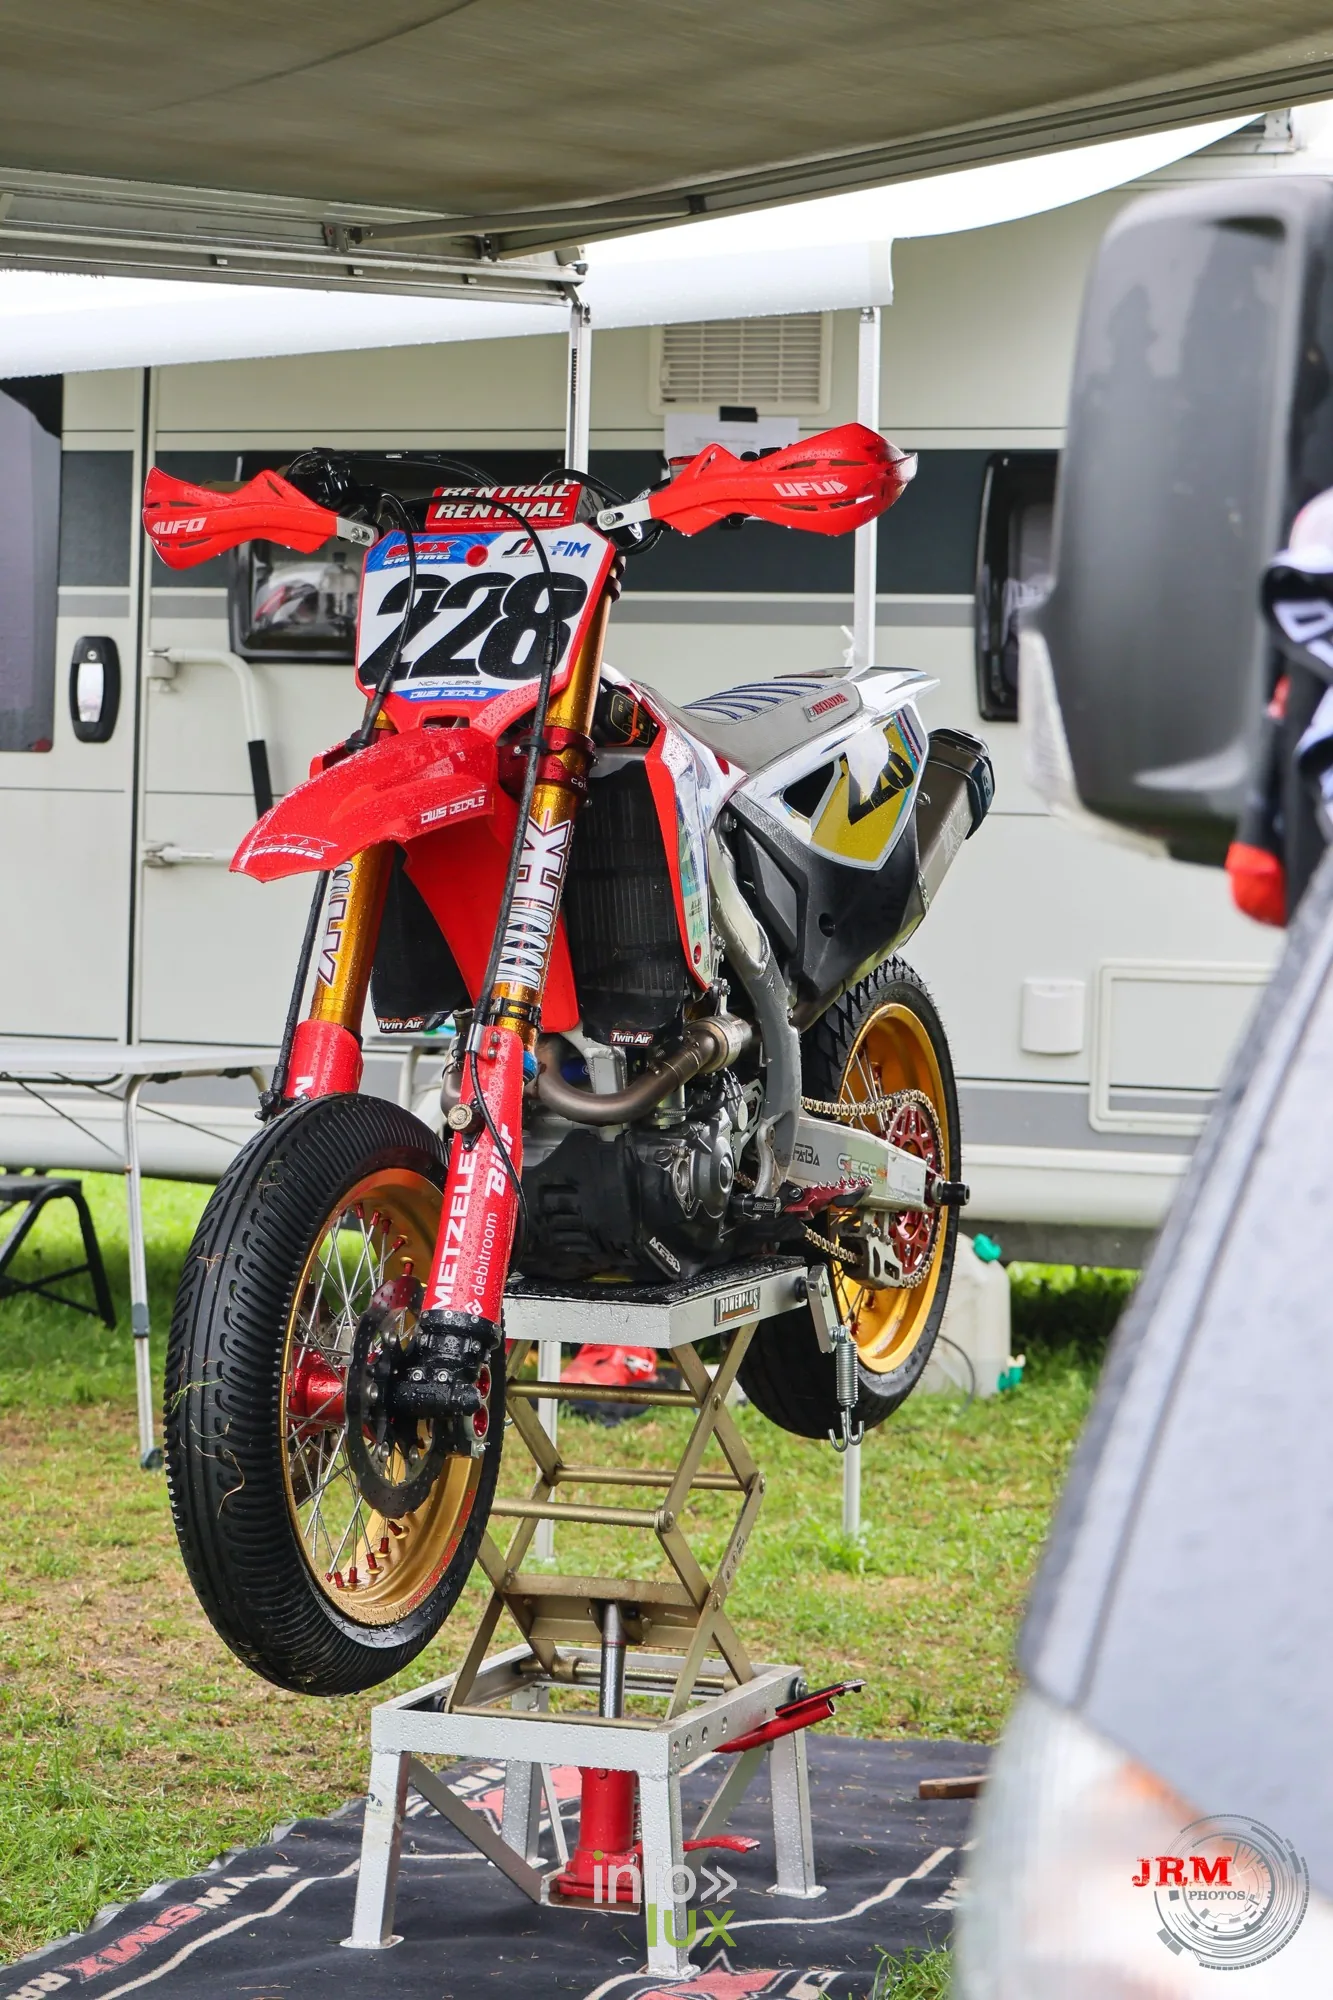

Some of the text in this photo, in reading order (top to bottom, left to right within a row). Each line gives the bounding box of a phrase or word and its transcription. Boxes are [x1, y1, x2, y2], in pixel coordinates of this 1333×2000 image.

[435, 502, 566, 519] RENTHAL
[153, 517, 207, 535] UFO
[551, 541, 591, 557] FIM
[383, 554, 451, 566] RAING
[358, 572, 588, 686] 228
[420, 796, 485, 824] DWS DECALS
[378, 1018, 423, 1029] Twin Air
[612, 1032, 652, 1044] Twin Air
[431, 1143, 479, 1310] METZELE
[472, 1212, 498, 1297] debitroom
